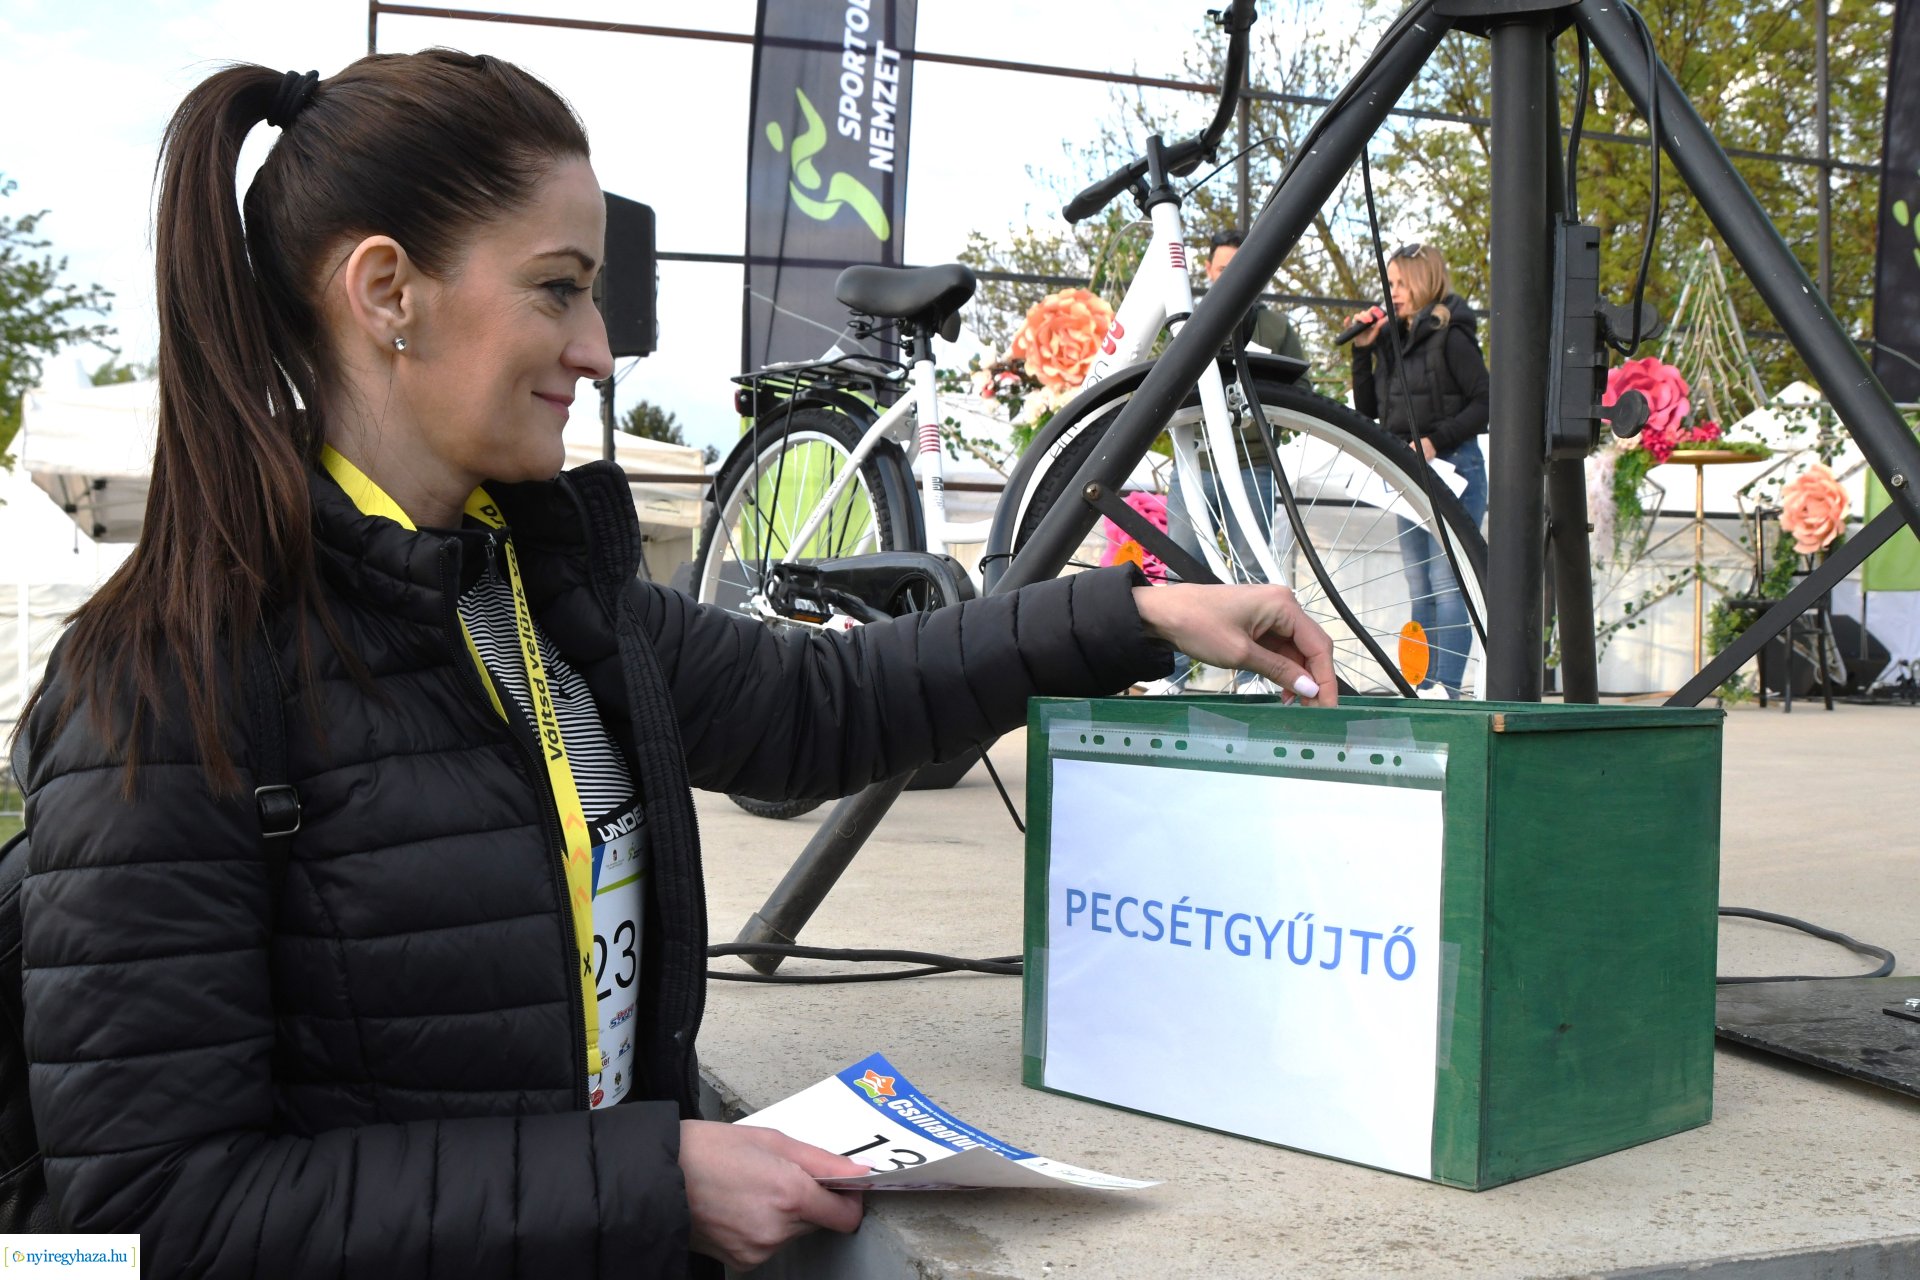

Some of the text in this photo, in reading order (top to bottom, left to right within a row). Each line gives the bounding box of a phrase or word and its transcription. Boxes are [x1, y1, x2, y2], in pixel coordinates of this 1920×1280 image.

[868, 40, 901, 173] NEMZET
[515, 584, 540, 671] velünk
[532, 678, 563, 761] Váltsd
[593, 919, 637, 1002] 23
[1065, 888, 1417, 981] PECSÉTGYŰJTŐ
[840, 1134, 927, 1173] 13
